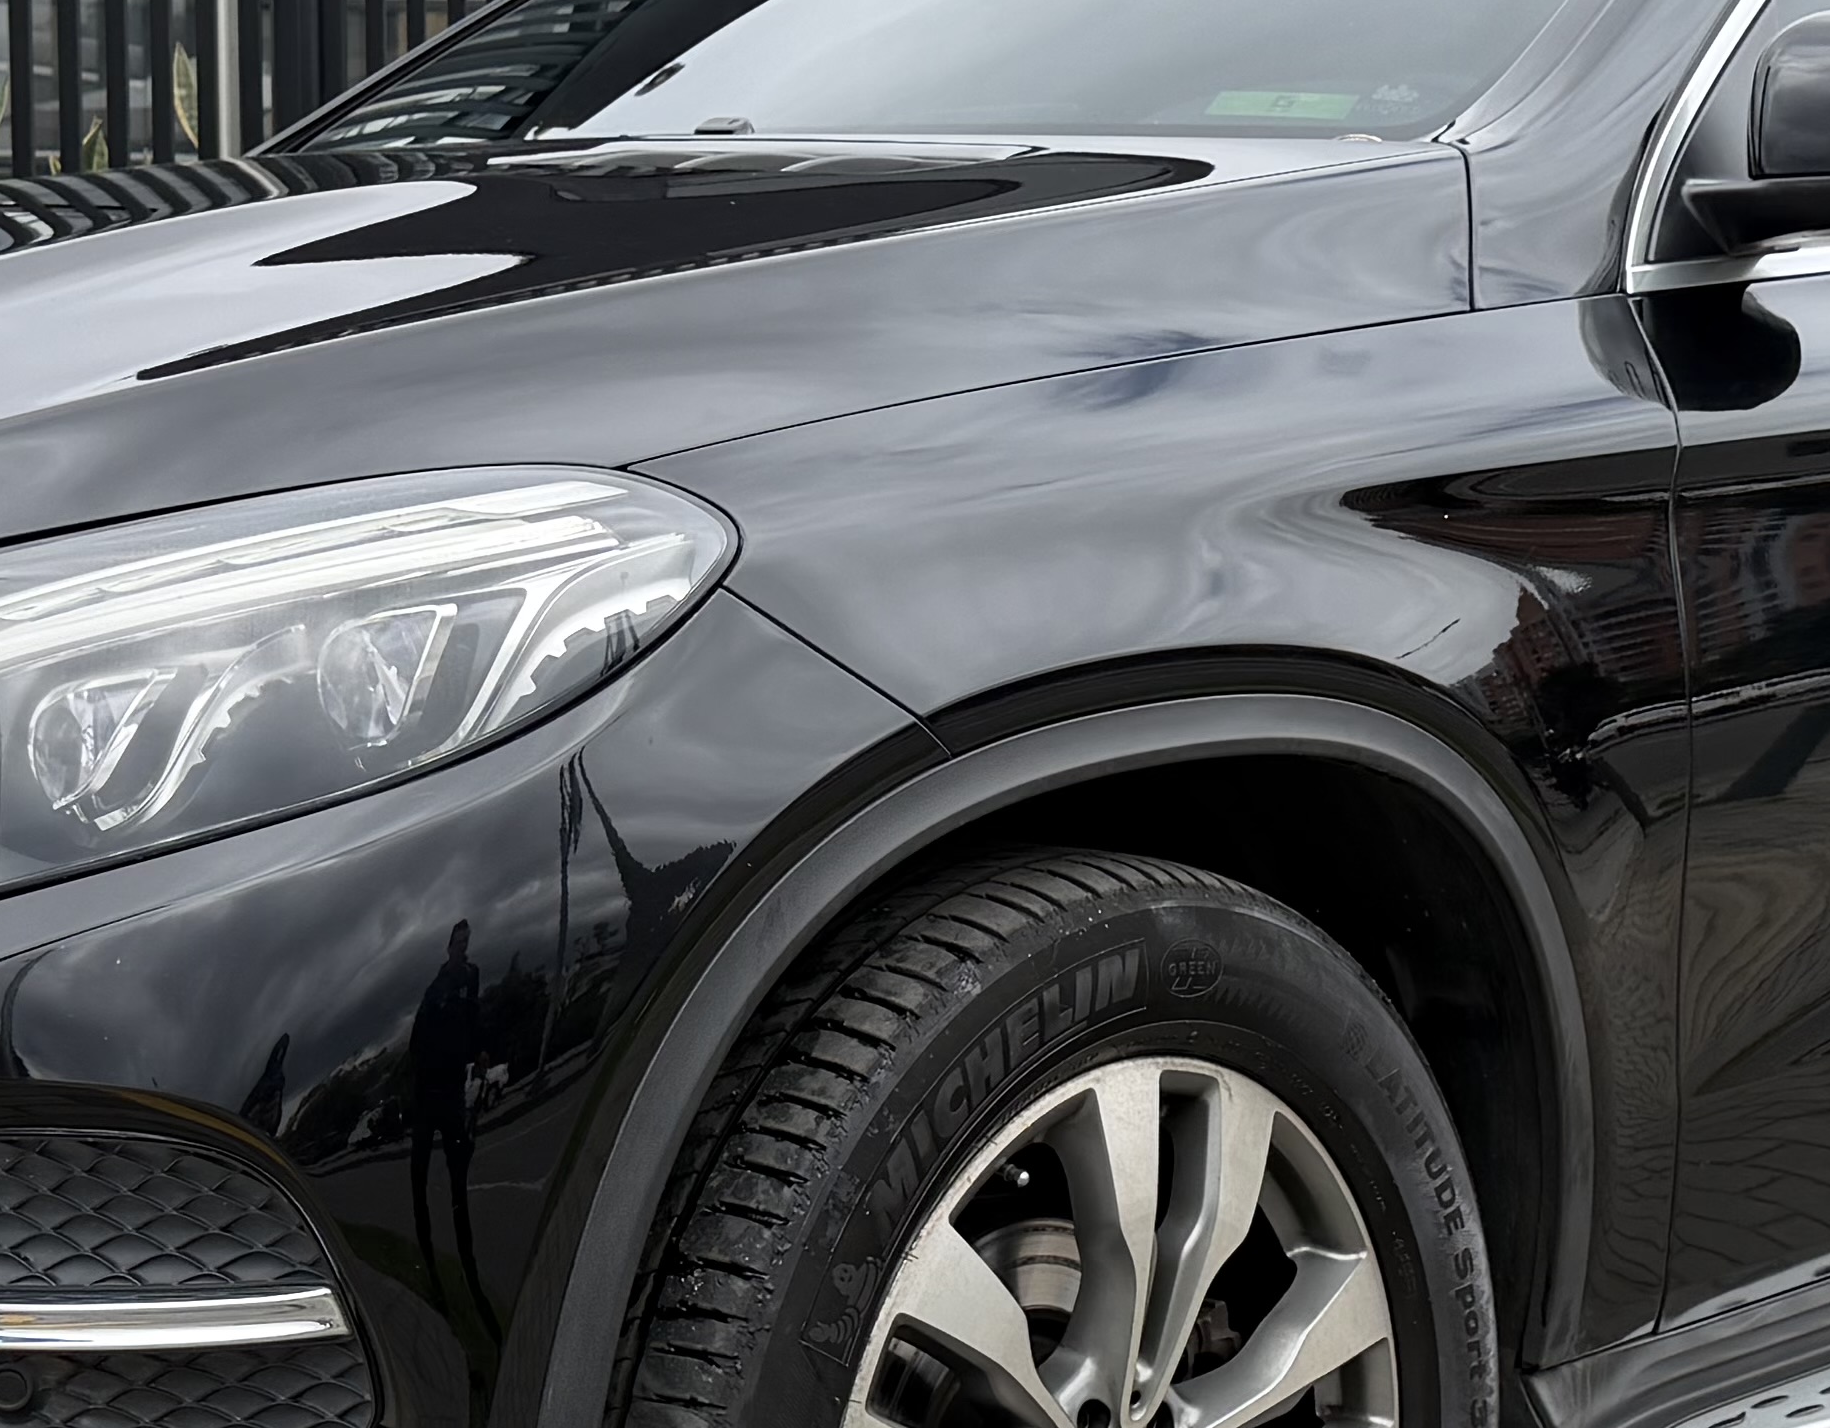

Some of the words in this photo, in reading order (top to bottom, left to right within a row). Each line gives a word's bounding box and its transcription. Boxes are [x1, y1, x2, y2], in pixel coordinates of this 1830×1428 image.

[1169, 958, 1218, 979] GREEN
[865, 949, 1140, 1232] MICHELIN
[1364, 1059, 1465, 1236] LATITUDE
